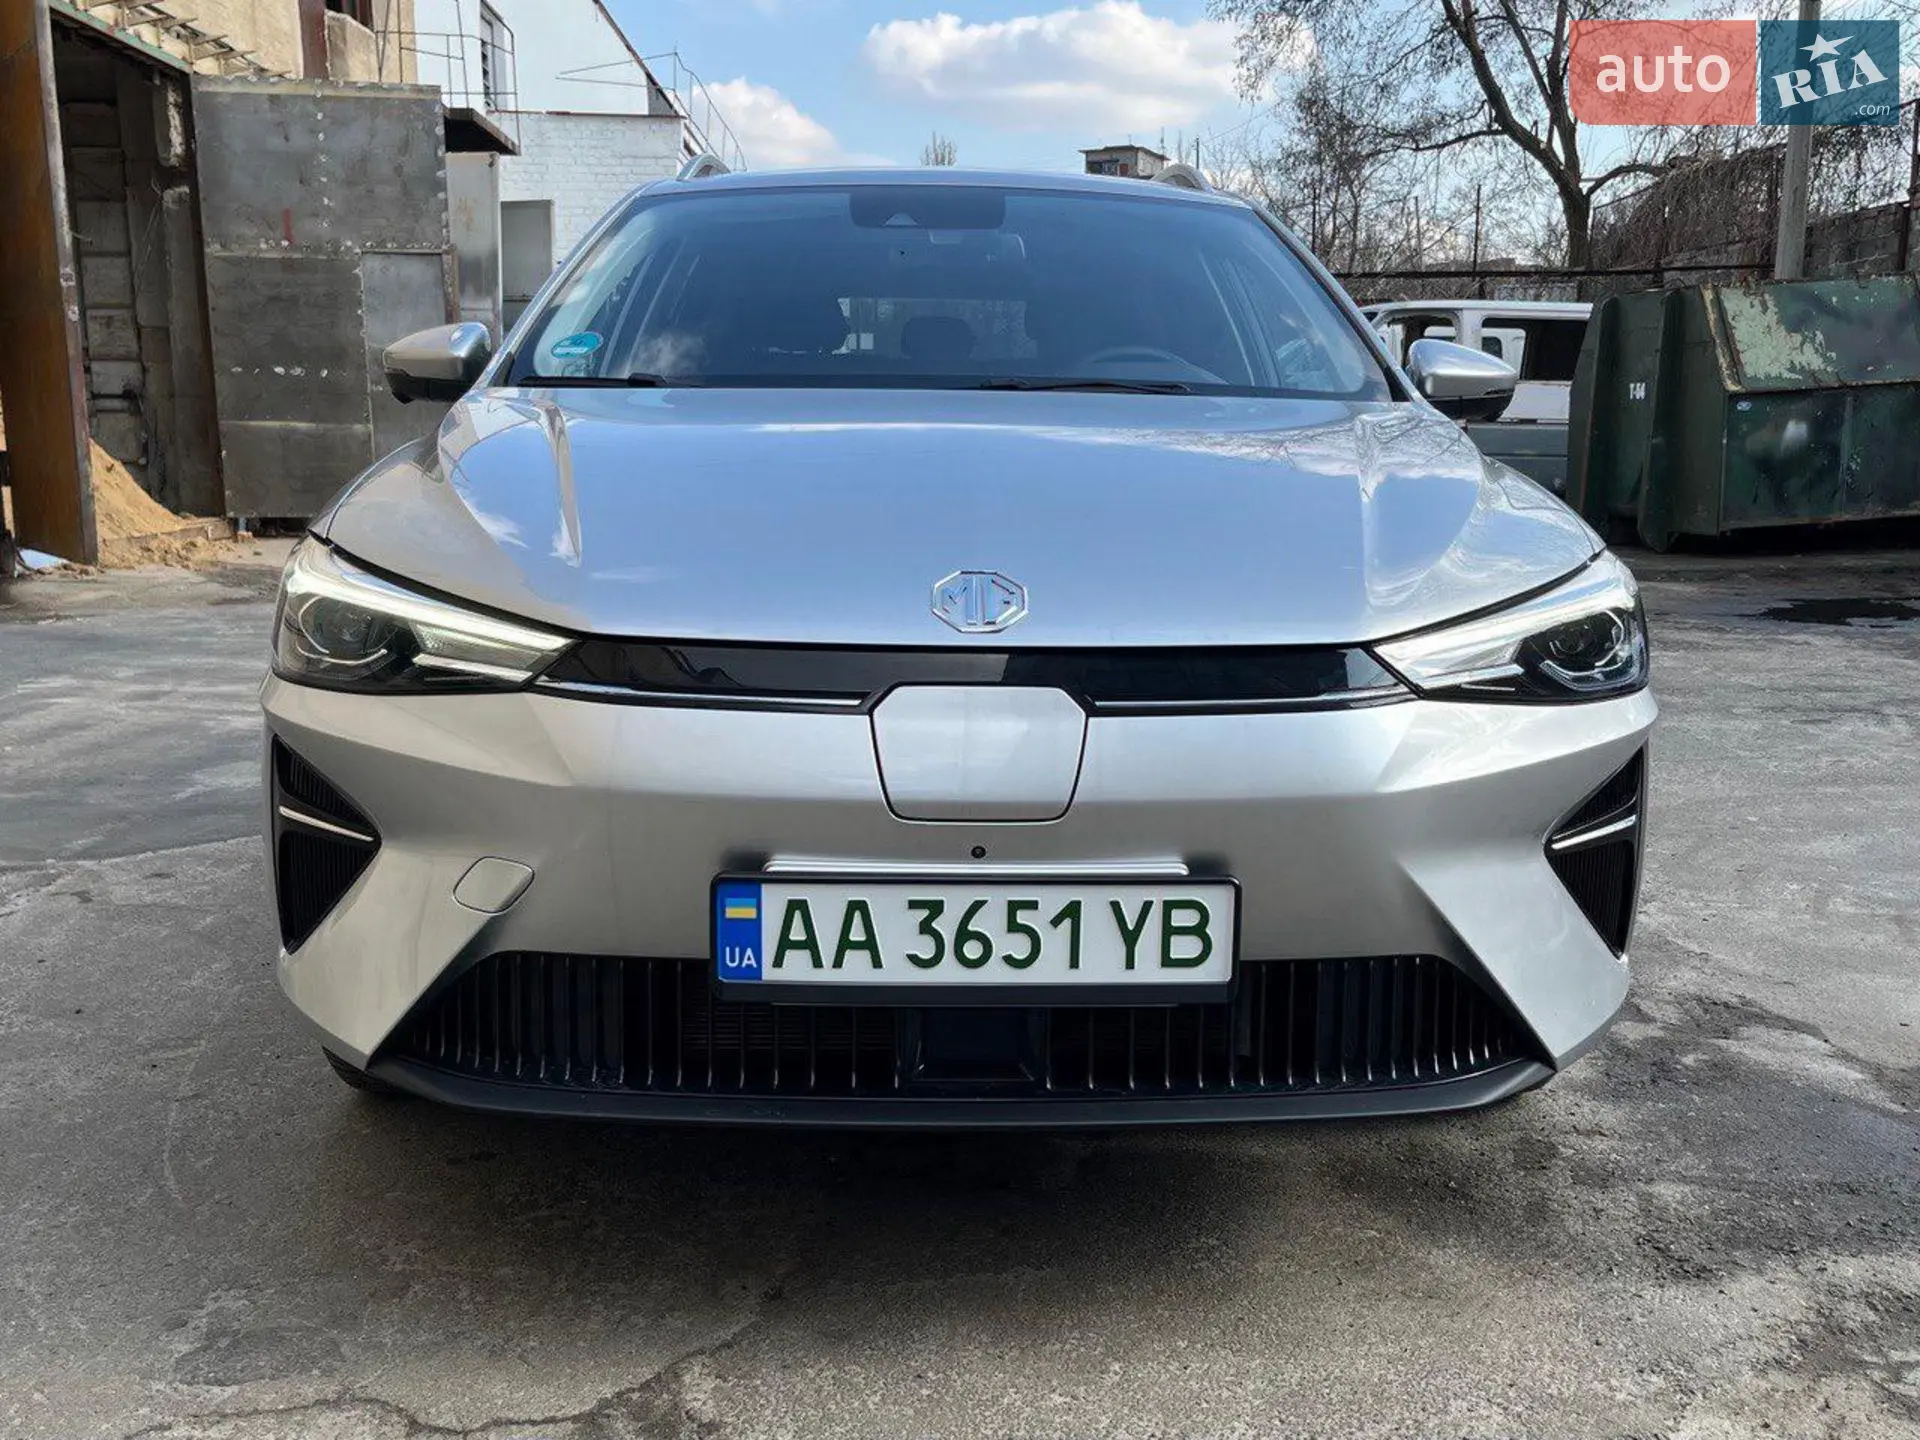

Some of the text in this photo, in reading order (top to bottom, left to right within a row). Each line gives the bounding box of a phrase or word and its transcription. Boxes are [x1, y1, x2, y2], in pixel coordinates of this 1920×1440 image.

[940, 576, 1018, 626] MG
[725, 946, 757, 968] UA
[771, 898, 1213, 970] AA 3651 YB
